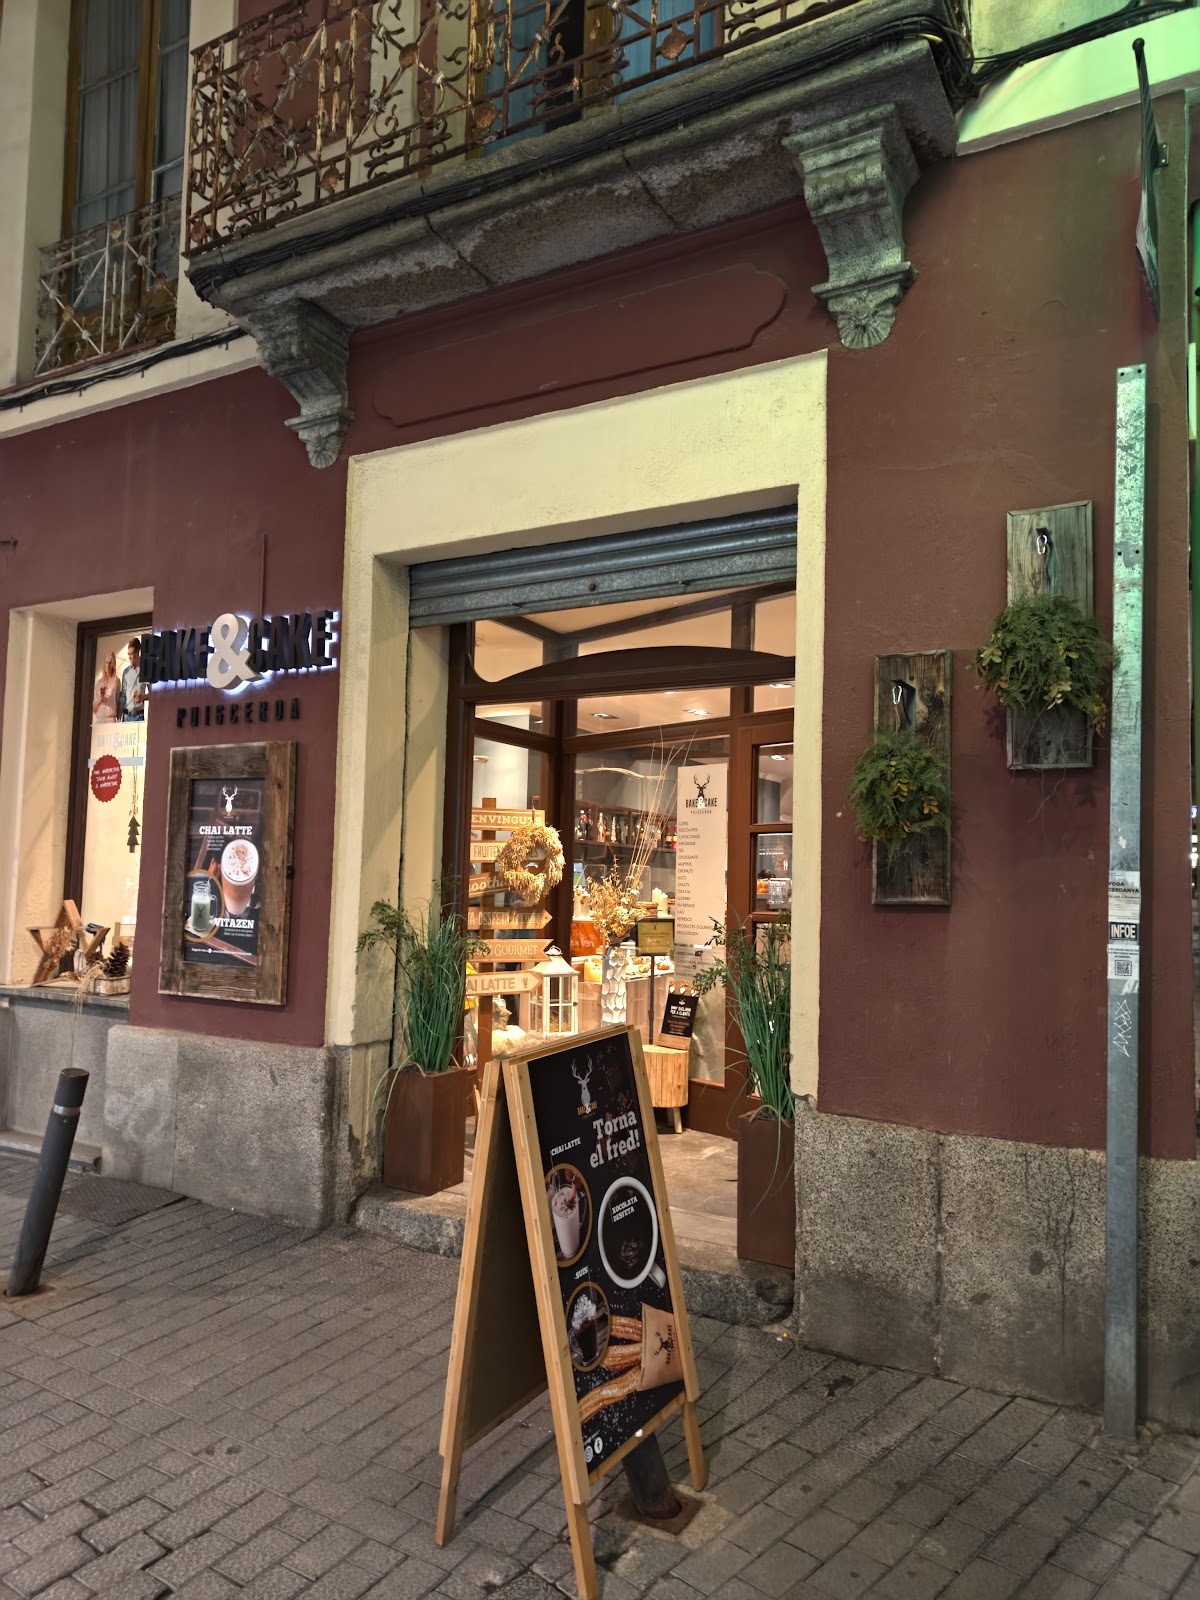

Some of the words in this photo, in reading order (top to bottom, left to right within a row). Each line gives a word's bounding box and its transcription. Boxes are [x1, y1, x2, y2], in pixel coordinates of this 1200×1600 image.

[471, 814, 542, 826] ENVINGUTS
[199, 825, 221, 835] CHAI
[222, 825, 253, 835] LATTE
[469, 875, 504, 892] oothi
[214, 917, 255, 929] VITAZEN
[1111, 923, 1136, 939] INFOE
[494, 943, 538, 957] GOURMET
[466, 978, 478, 991] AI
[481, 977, 515, 991] LATTE
[592, 1110, 637, 1140] Torna
[551, 1146, 565, 1156] CHAI
[564, 1137, 581, 1151] LATTE
[589, 1143, 605, 1168] el
[606, 1129, 640, 1161] fred!
[611, 1195, 638, 1215] XOCOLATA
